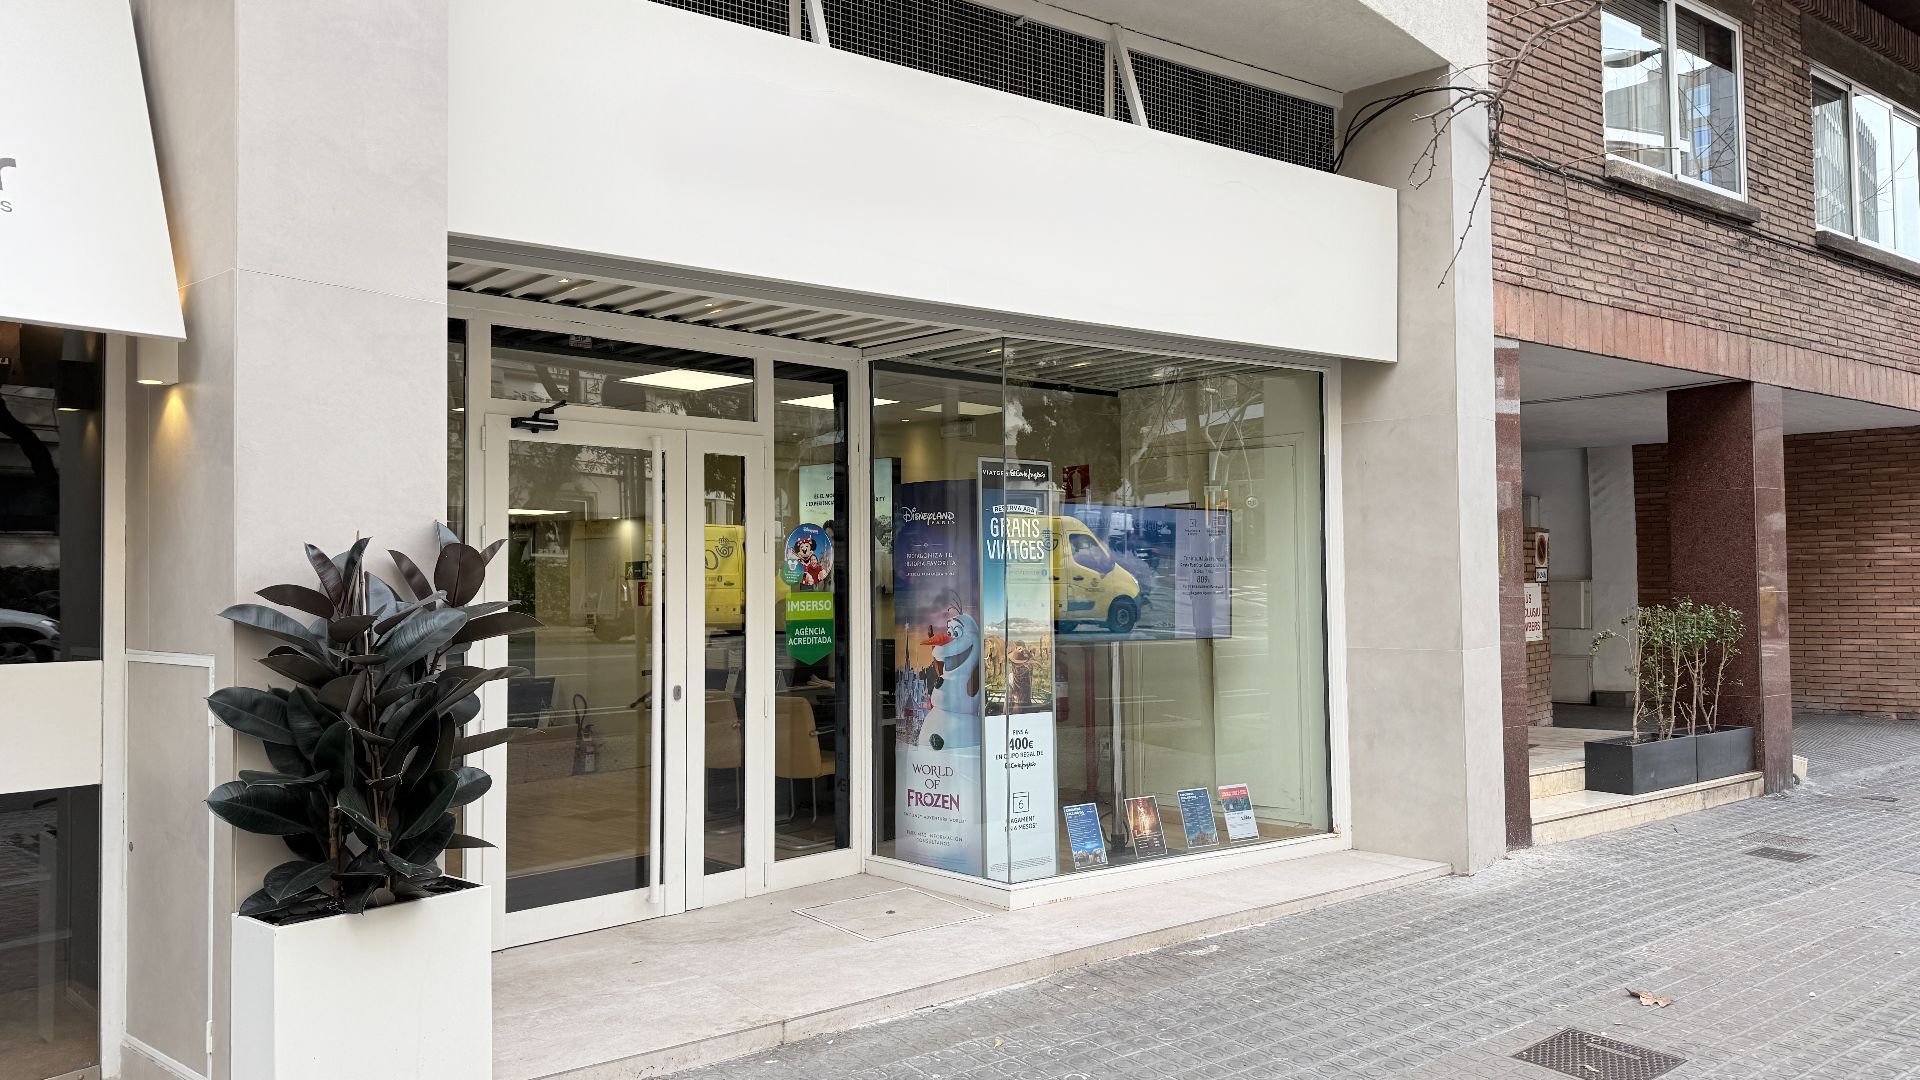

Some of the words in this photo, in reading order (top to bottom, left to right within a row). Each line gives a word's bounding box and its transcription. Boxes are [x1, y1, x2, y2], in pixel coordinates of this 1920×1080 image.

[990, 517, 1040, 539] GRANS
[986, 539, 1045, 561] VIATGES
[787, 600, 832, 612] IMSERSO
[788, 636, 832, 645] ACREDITADA
[1009, 737, 1034, 750] 400€
[912, 763, 954, 778] WORLD
[924, 778, 941, 789] OF
[907, 788, 960, 812] FROZEN
